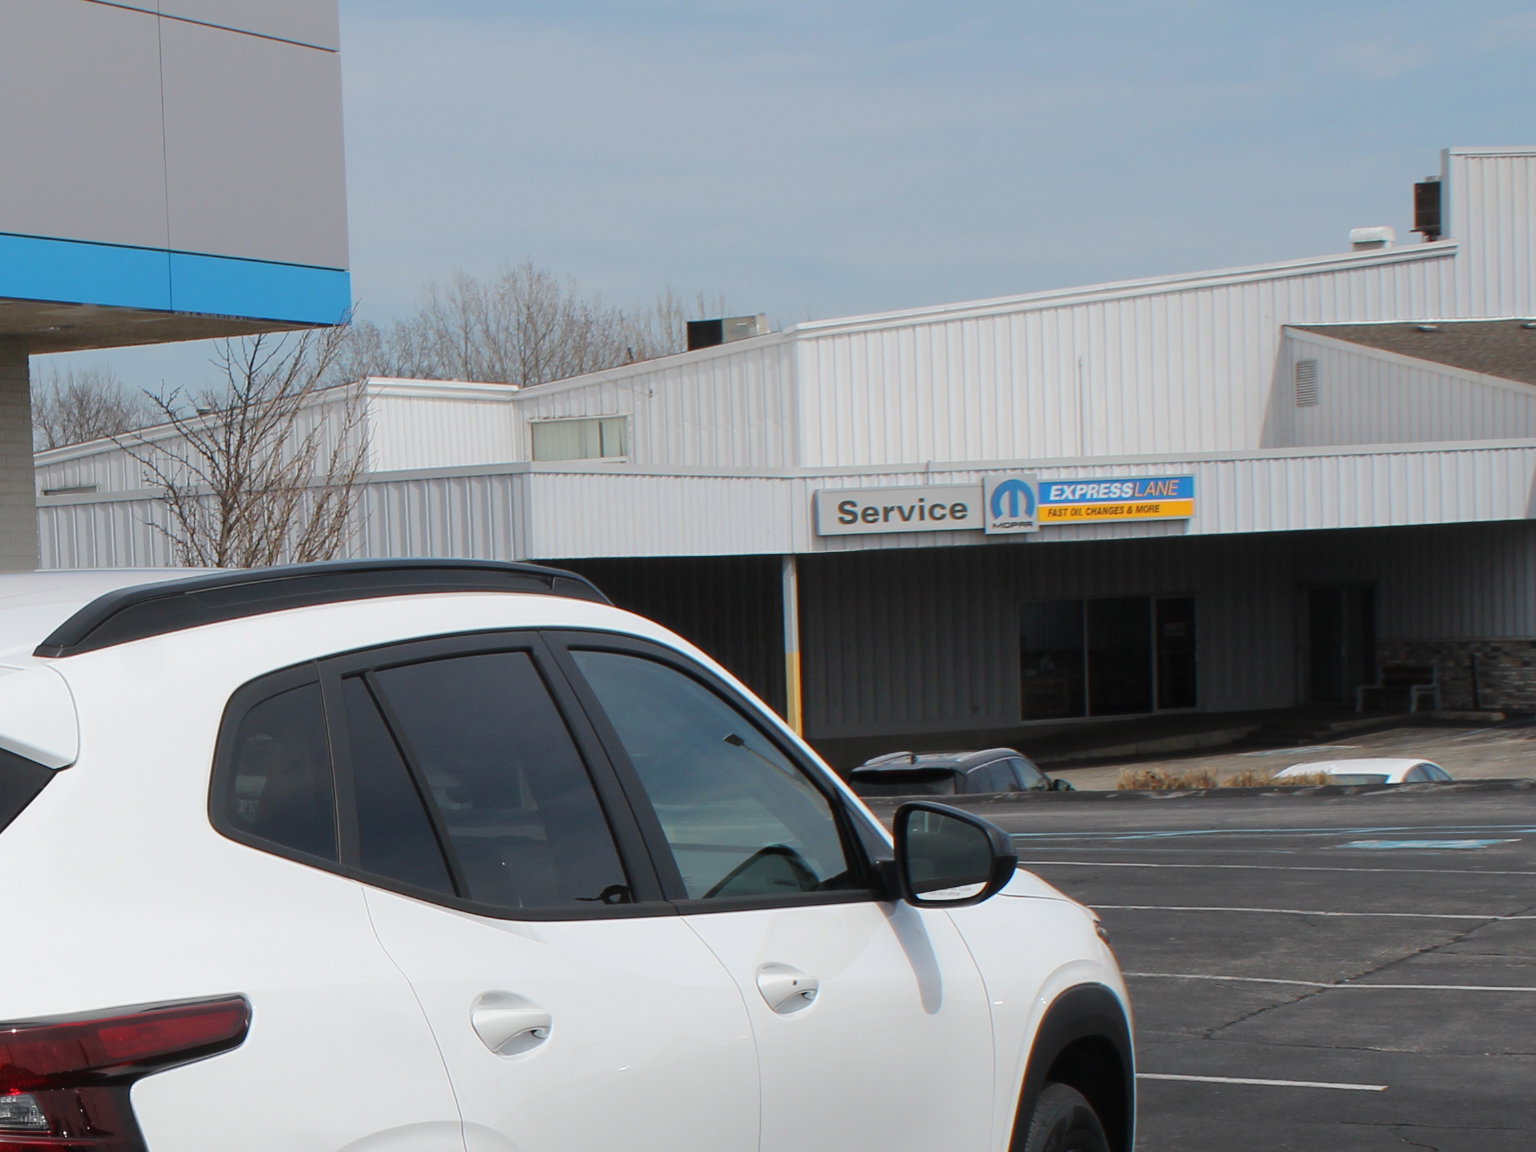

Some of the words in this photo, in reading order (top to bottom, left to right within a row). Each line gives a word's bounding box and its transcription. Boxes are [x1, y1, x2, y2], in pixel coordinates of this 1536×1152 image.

[837, 497, 969, 525] Service
[1047, 508, 1068, 517] FAST
[1070, 507, 1083, 516] OIL
[1085, 505, 1124, 516] CHANGES
[1126, 506, 1133, 514] &
[1135, 504, 1160, 513] MORE
